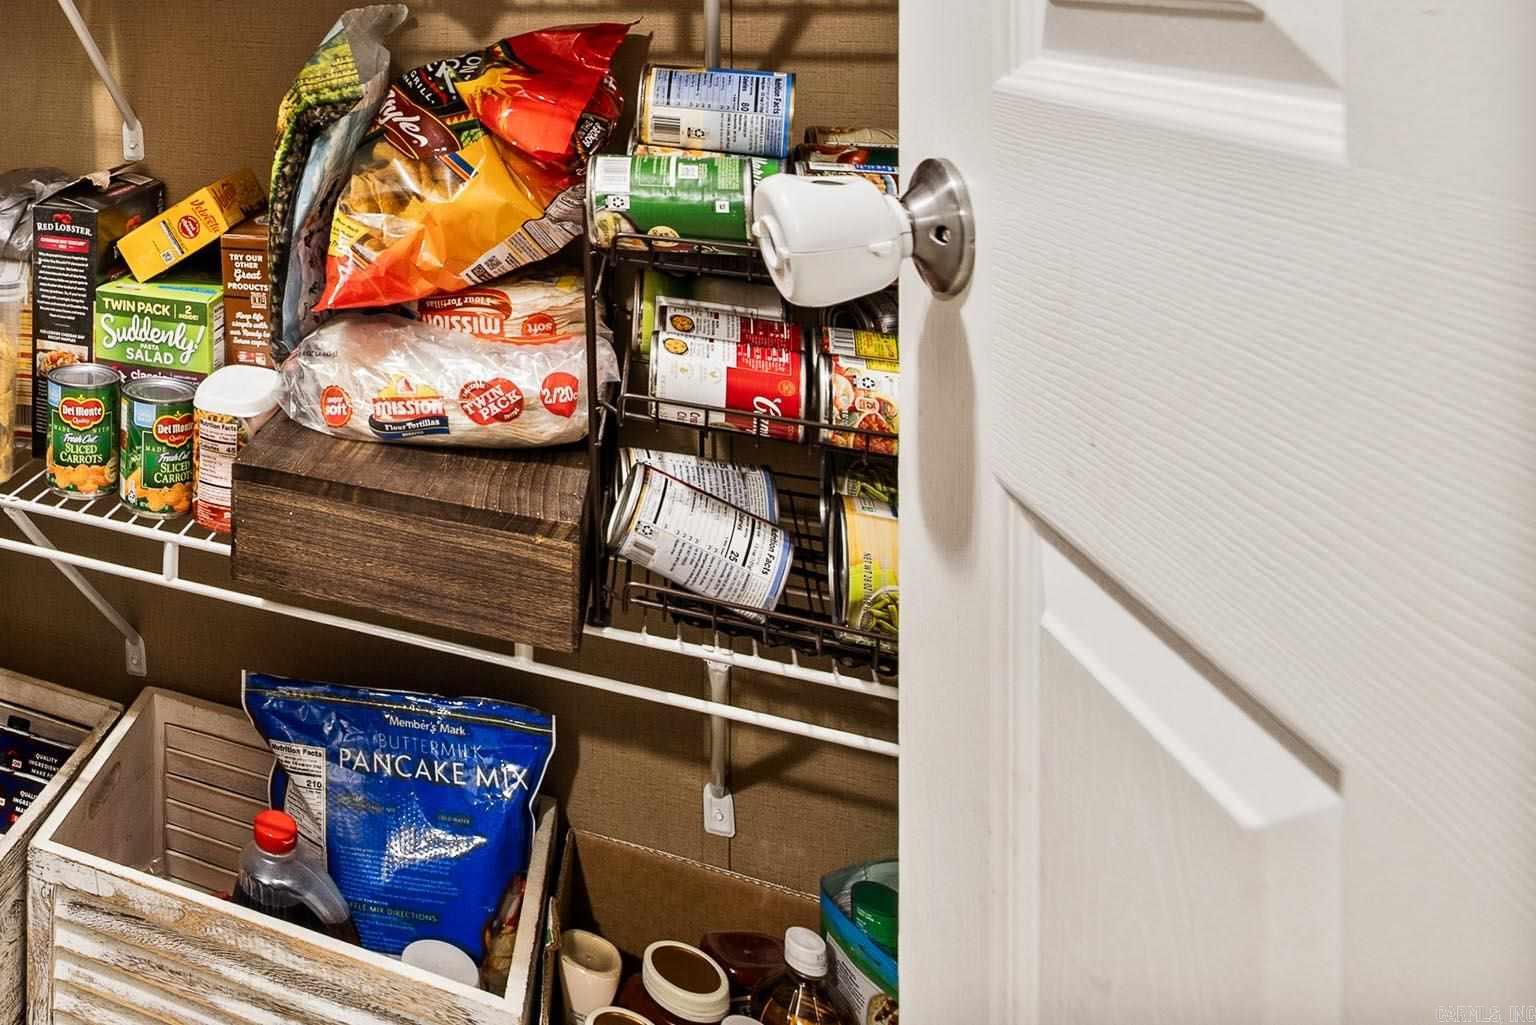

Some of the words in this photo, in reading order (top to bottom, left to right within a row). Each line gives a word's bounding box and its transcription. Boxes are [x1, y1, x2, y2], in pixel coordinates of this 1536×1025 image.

[36, 222, 54, 232] RED
[54, 224, 93, 237] LOBSTER
[229, 253, 244, 262] TRY
[245, 254, 263, 263] OUR
[234, 261, 259, 269] OTHER
[233, 268, 262, 282] Great
[228, 282, 270, 293] PRODUCTS
[102, 297, 137, 313] TWIN
[137, 301, 170, 316] PACK
[184, 305, 193, 314] 2
[100, 312, 207, 365] Suddenly!
[125, 347, 174, 365] SALAD
[464, 384, 506, 414] TWIN
[62, 405, 75, 416] Del
[76, 406, 102, 417] Monte
[326, 404, 348, 418] soft
[480, 390, 522, 421] PACK
[157, 423, 172, 434] Del
[384, 422, 407, 431] Flour
[408, 419, 440, 429] Tortillas
[65, 443, 98, 455] SLICED
[59, 452, 103, 464] CARROTS
[154, 471, 193, 484] CARROT
[388, 715, 438, 733] Member's
[439, 722, 465, 736] Mark
[302, 748, 323, 758] Facts
[378, 732, 484, 763] BUTTERMILK
[34, 752, 59, 764] QUALITY
[338, 747, 467, 786] PANCAKE
[476, 765, 530, 792] MIX
[306, 779, 323, 788] 210
